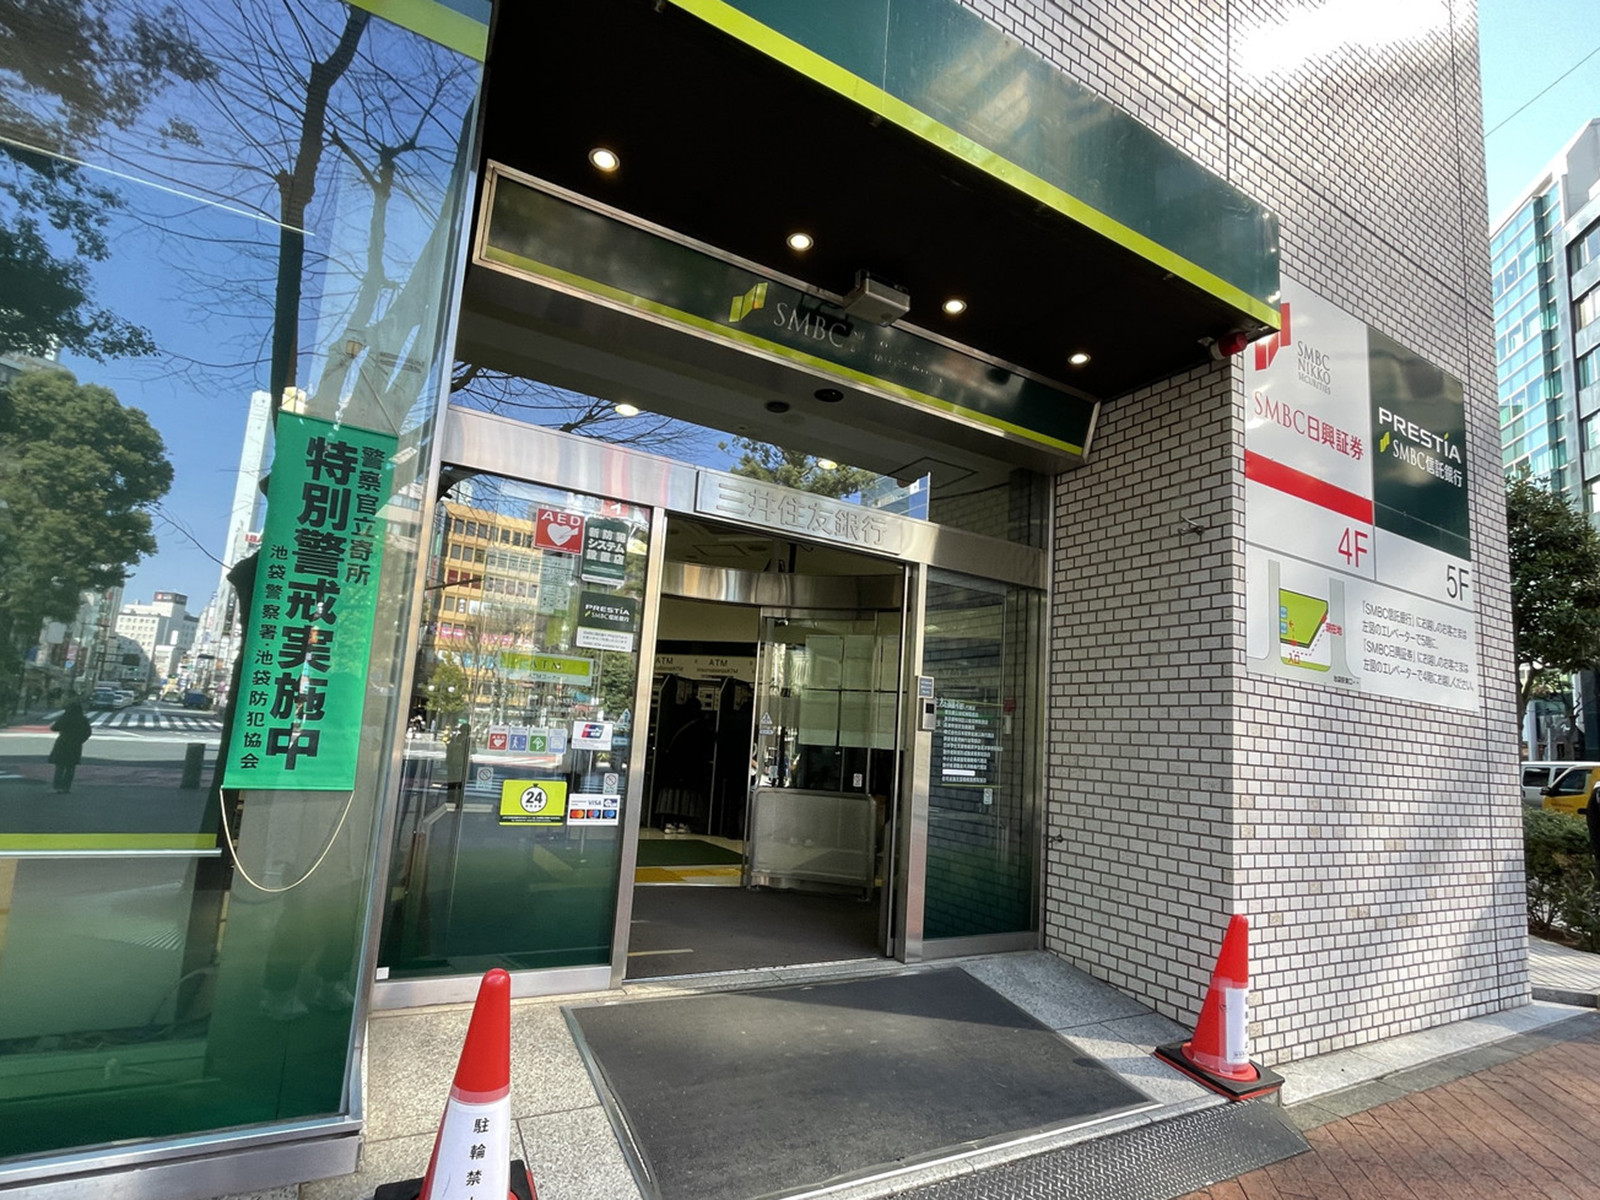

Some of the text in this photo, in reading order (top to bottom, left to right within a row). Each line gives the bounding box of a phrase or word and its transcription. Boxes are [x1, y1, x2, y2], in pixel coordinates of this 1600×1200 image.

[773, 302, 847, 348] SMBC
[1297, 340, 1330, 371] SMBC
[1297, 357, 1331, 385] NIKKO
[1254, 391, 1364, 462] SMBC日興証券
[1393, 439, 1462, 488] SMBC信託銀行
[345, 446, 386, 586] 警察官立寄所
[541, 511, 581, 527] AED
[715, 482, 888, 546] 三井住友銀行
[588, 538, 625, 554] システム
[1338, 527, 1369, 568] 4F
[1446, 564, 1470, 601] 5F
[265, 436, 359, 771] 特別警戒実施中
[708, 659, 729, 667] ATM
[525, 790, 543, 805] 24
